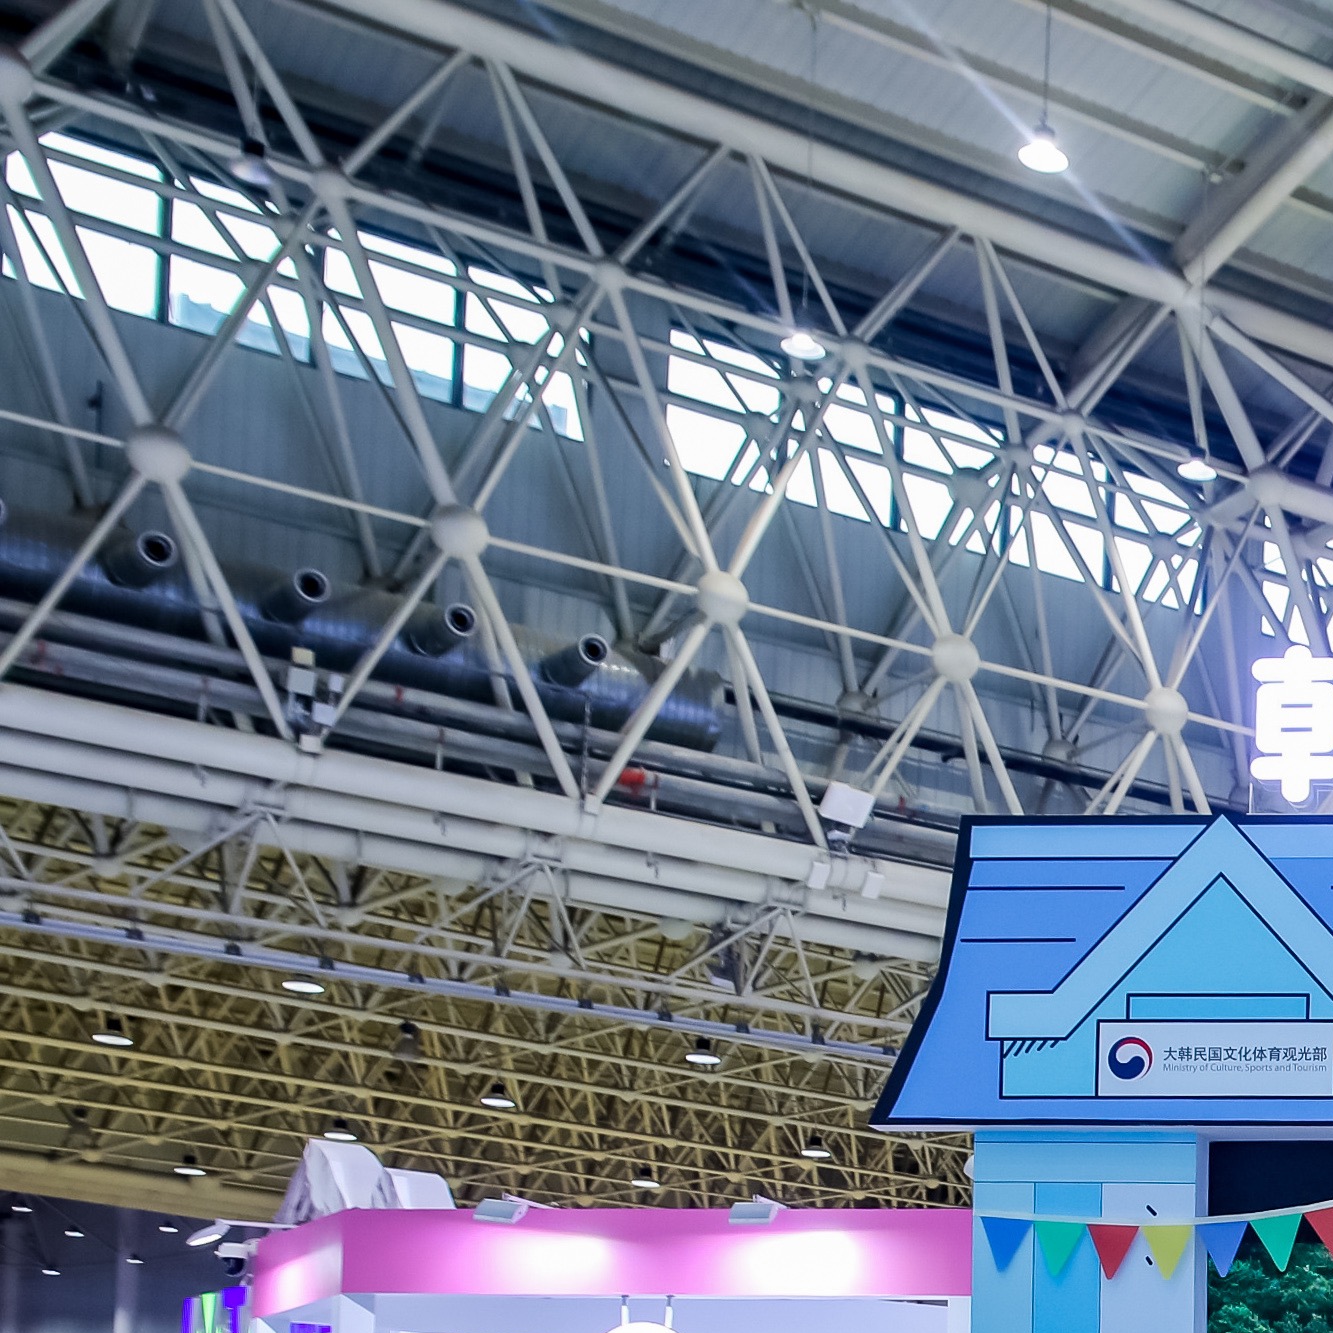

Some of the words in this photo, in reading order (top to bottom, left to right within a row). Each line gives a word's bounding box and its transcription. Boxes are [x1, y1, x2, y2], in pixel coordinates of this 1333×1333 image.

[1162, 1046, 1328, 1062] 大韩民国文化体育观光部
[1162, 1062, 1197, 1073] Ministry
[1198, 1062, 1210, 1072] of
[1210, 1062, 1244, 1073] Culture,
[1245, 1063, 1273, 1074] Sports
[1274, 1062, 1292, 1072] and
[1293, 1063, 1328, 1072] Tourism
